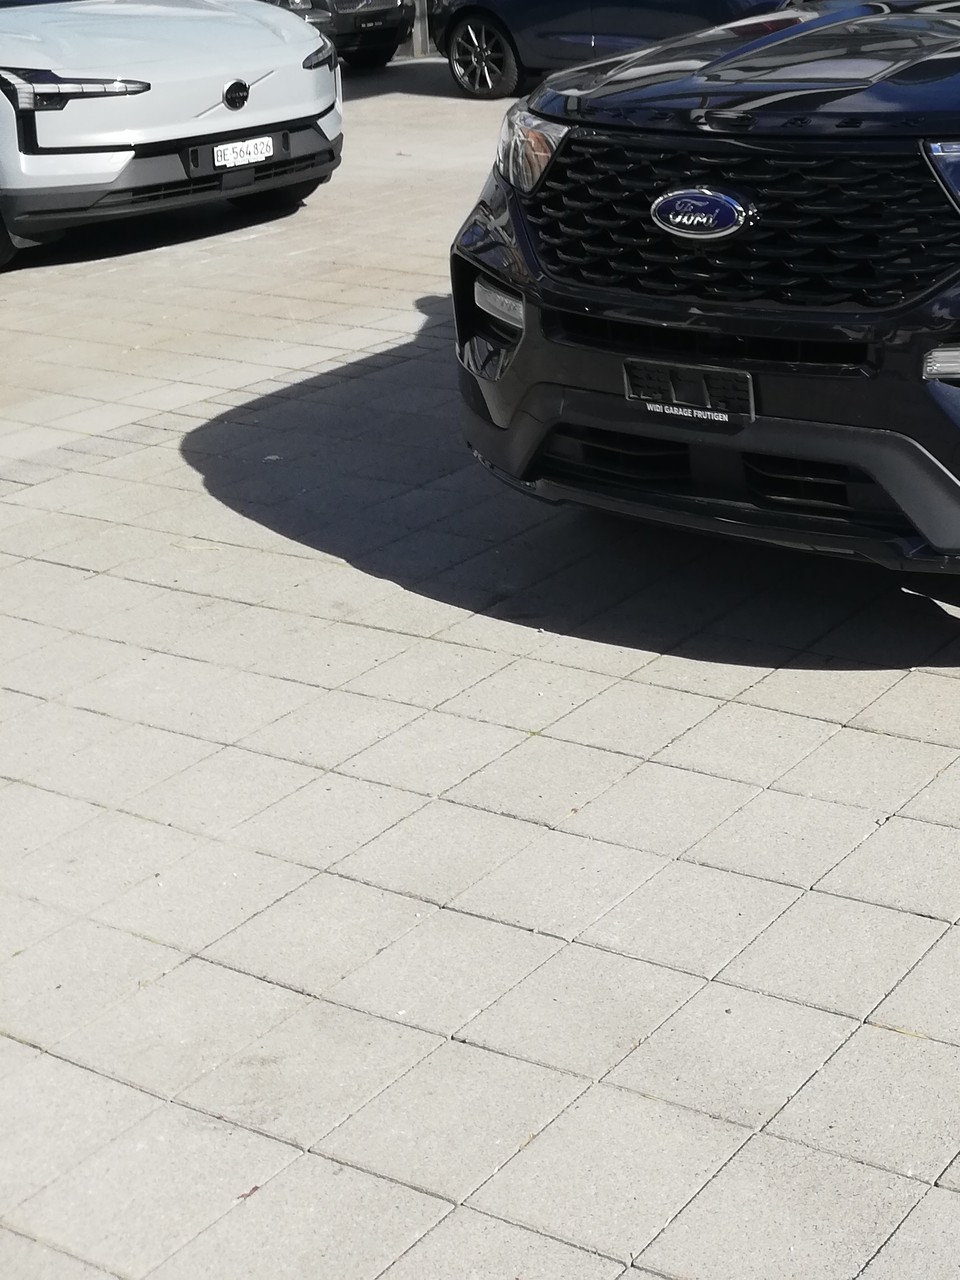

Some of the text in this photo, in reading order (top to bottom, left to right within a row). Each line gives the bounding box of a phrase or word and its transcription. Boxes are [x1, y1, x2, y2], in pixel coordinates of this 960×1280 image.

[669, 198, 720, 228] Ford
[646, 402, 729, 422] WIDI GARAGE FRUTIGEN
